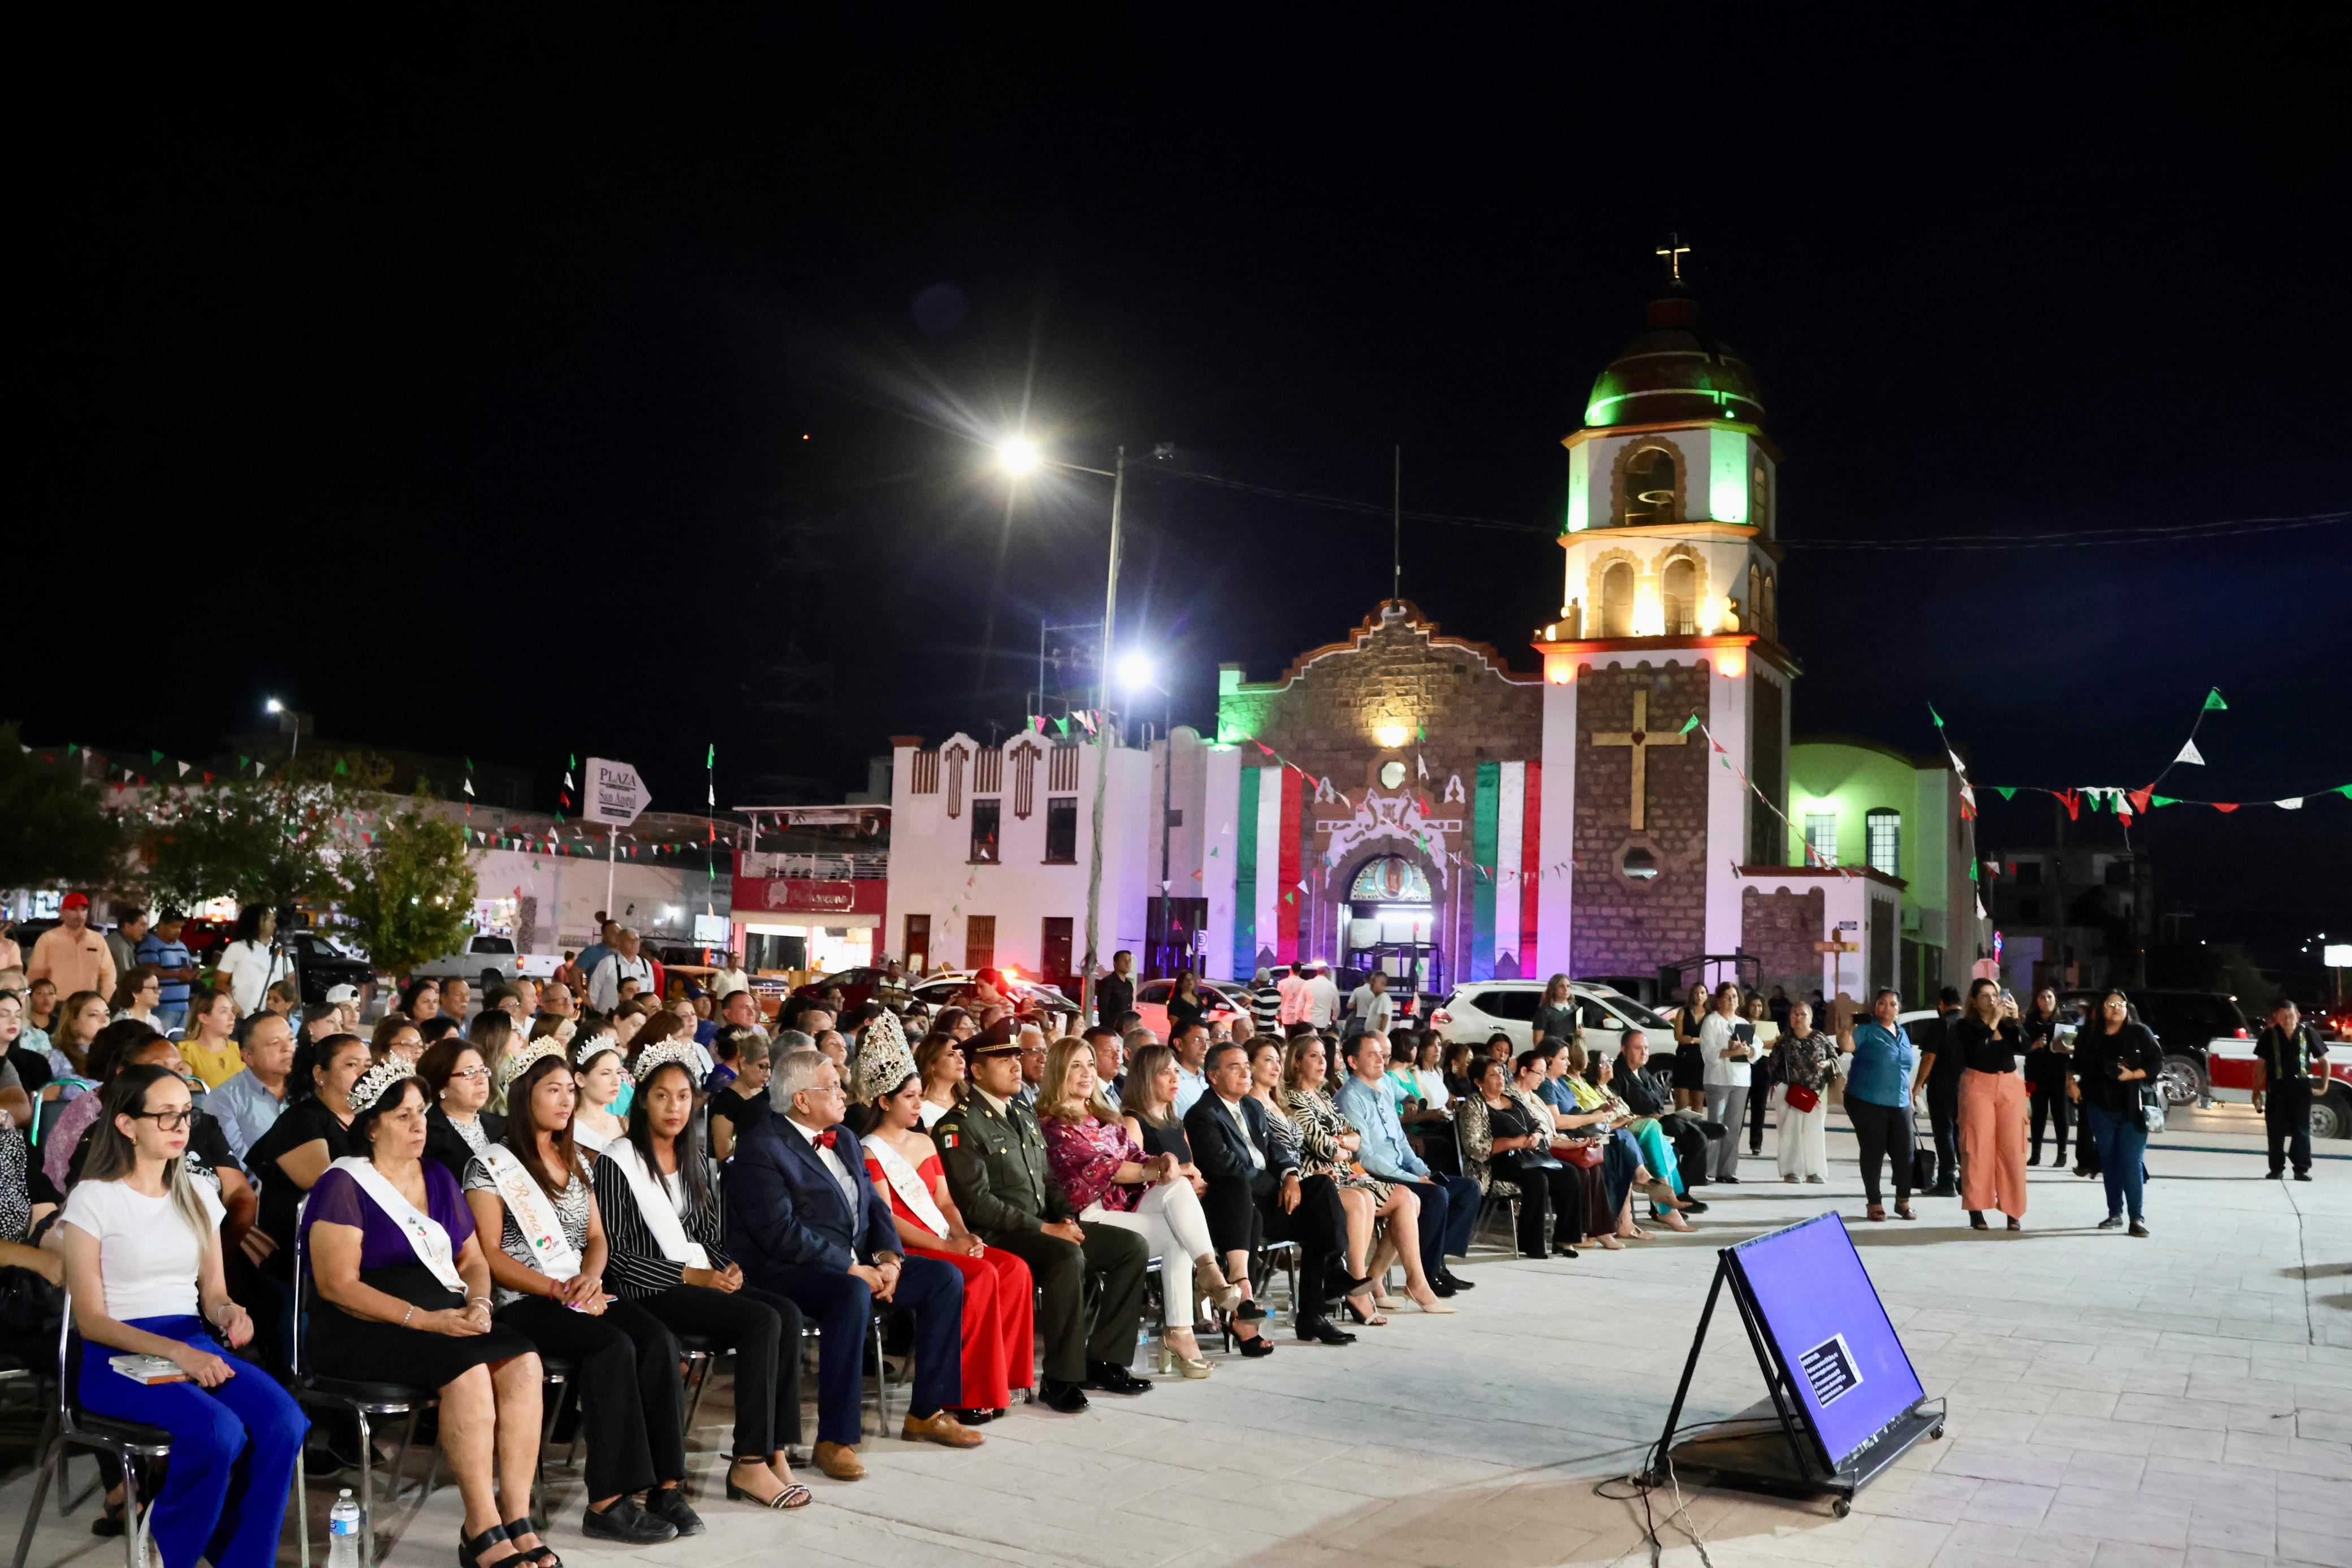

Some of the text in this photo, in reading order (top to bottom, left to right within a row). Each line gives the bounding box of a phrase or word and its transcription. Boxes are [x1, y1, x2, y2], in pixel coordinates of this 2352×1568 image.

[599, 768, 636, 786] PLAZA
[599, 788, 613, 803] San
[507, 1173, 543, 1233] Reina
